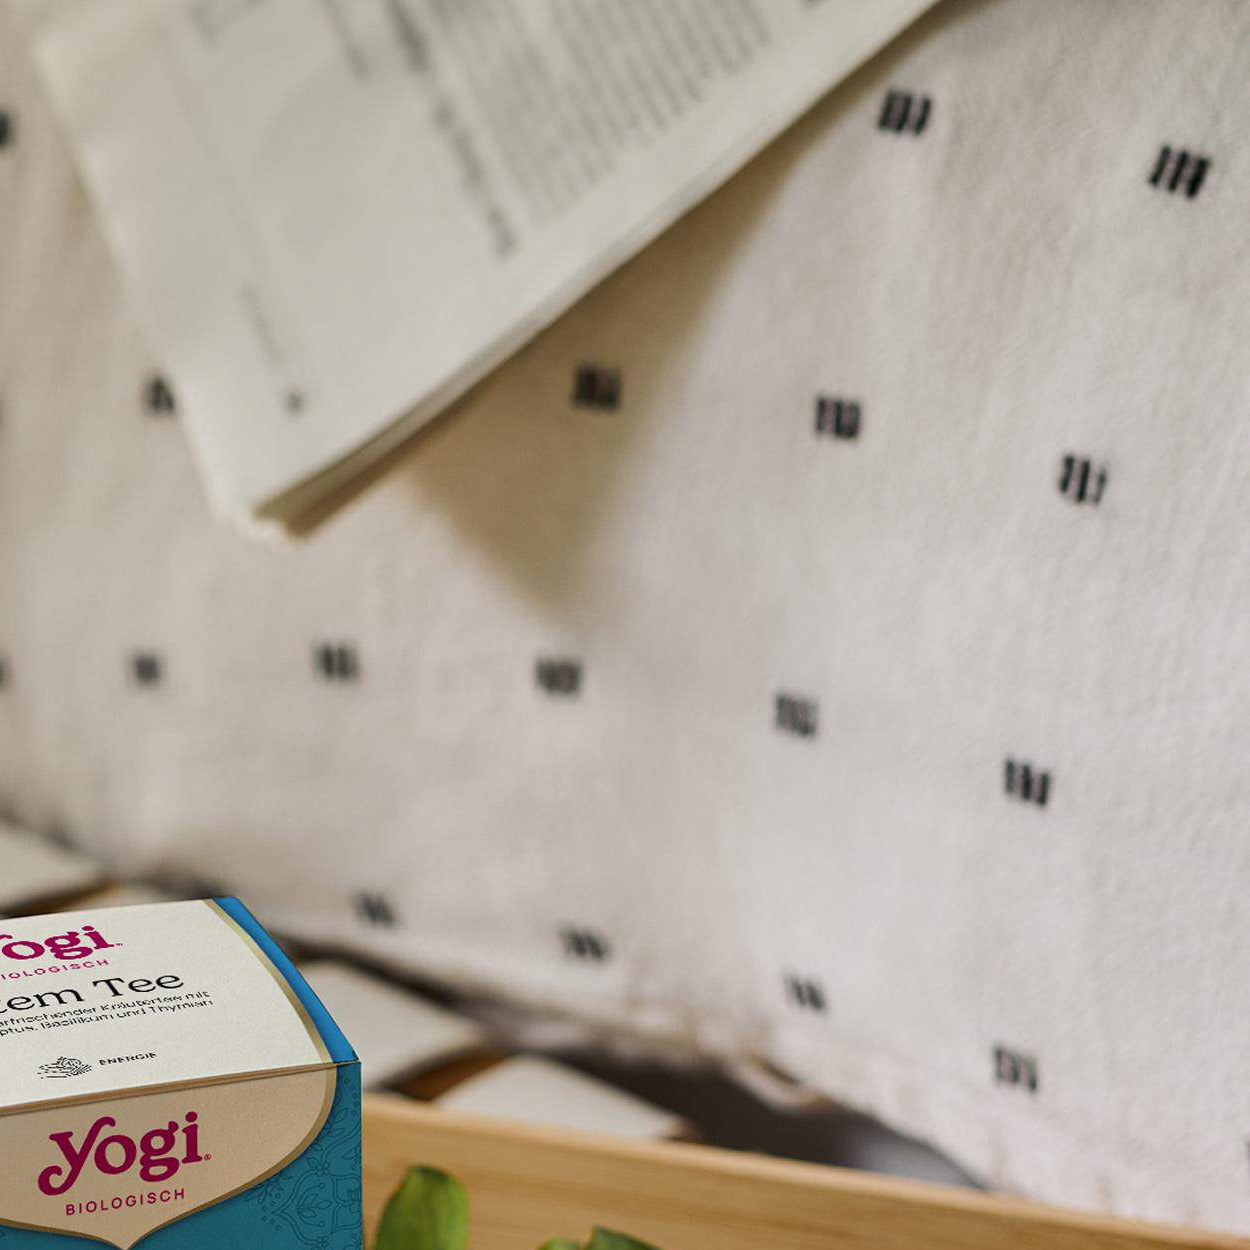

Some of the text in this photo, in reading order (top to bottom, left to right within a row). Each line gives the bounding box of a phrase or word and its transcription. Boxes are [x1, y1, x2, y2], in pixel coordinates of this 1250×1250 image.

[92, 974, 185, 998] Tee
[116, 1007, 147, 1020] und
[65, 1188, 186, 1216] BIOLOGISCH
